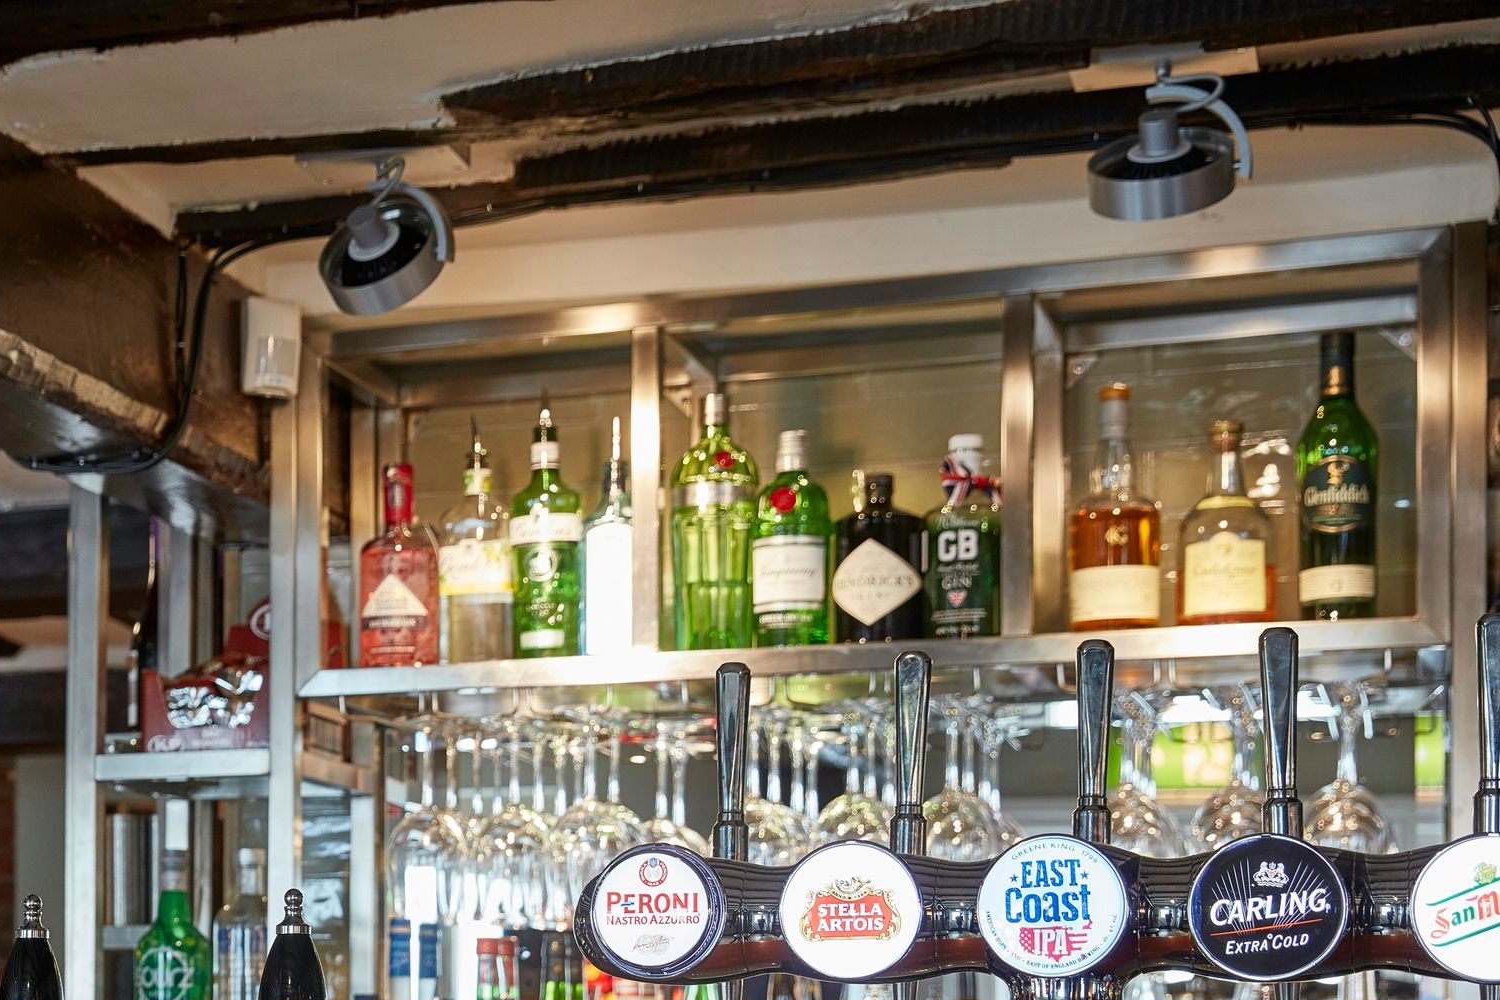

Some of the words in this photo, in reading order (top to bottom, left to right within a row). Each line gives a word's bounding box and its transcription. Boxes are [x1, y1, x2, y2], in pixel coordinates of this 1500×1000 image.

[937, 528, 979, 562] GB
[1011, 842, 1048, 861] GREENE
[1050, 842, 1075, 851] KING
[1081, 850, 1098, 863] 1799
[1020, 859, 1081, 888] EAST
[607, 892, 699, 914] PERONI
[817, 903, 883, 917] STELLA
[1005, 884, 1091, 923] Coast
[1210, 888, 1327, 926] CARLING
[607, 915, 648, 925] NASTRO
[649, 915, 701, 925] AZZURRO
[816, 917, 884, 932] ARTOIS
[1431, 907, 1475, 938] San
[1033, 929, 1070, 955] IPA
